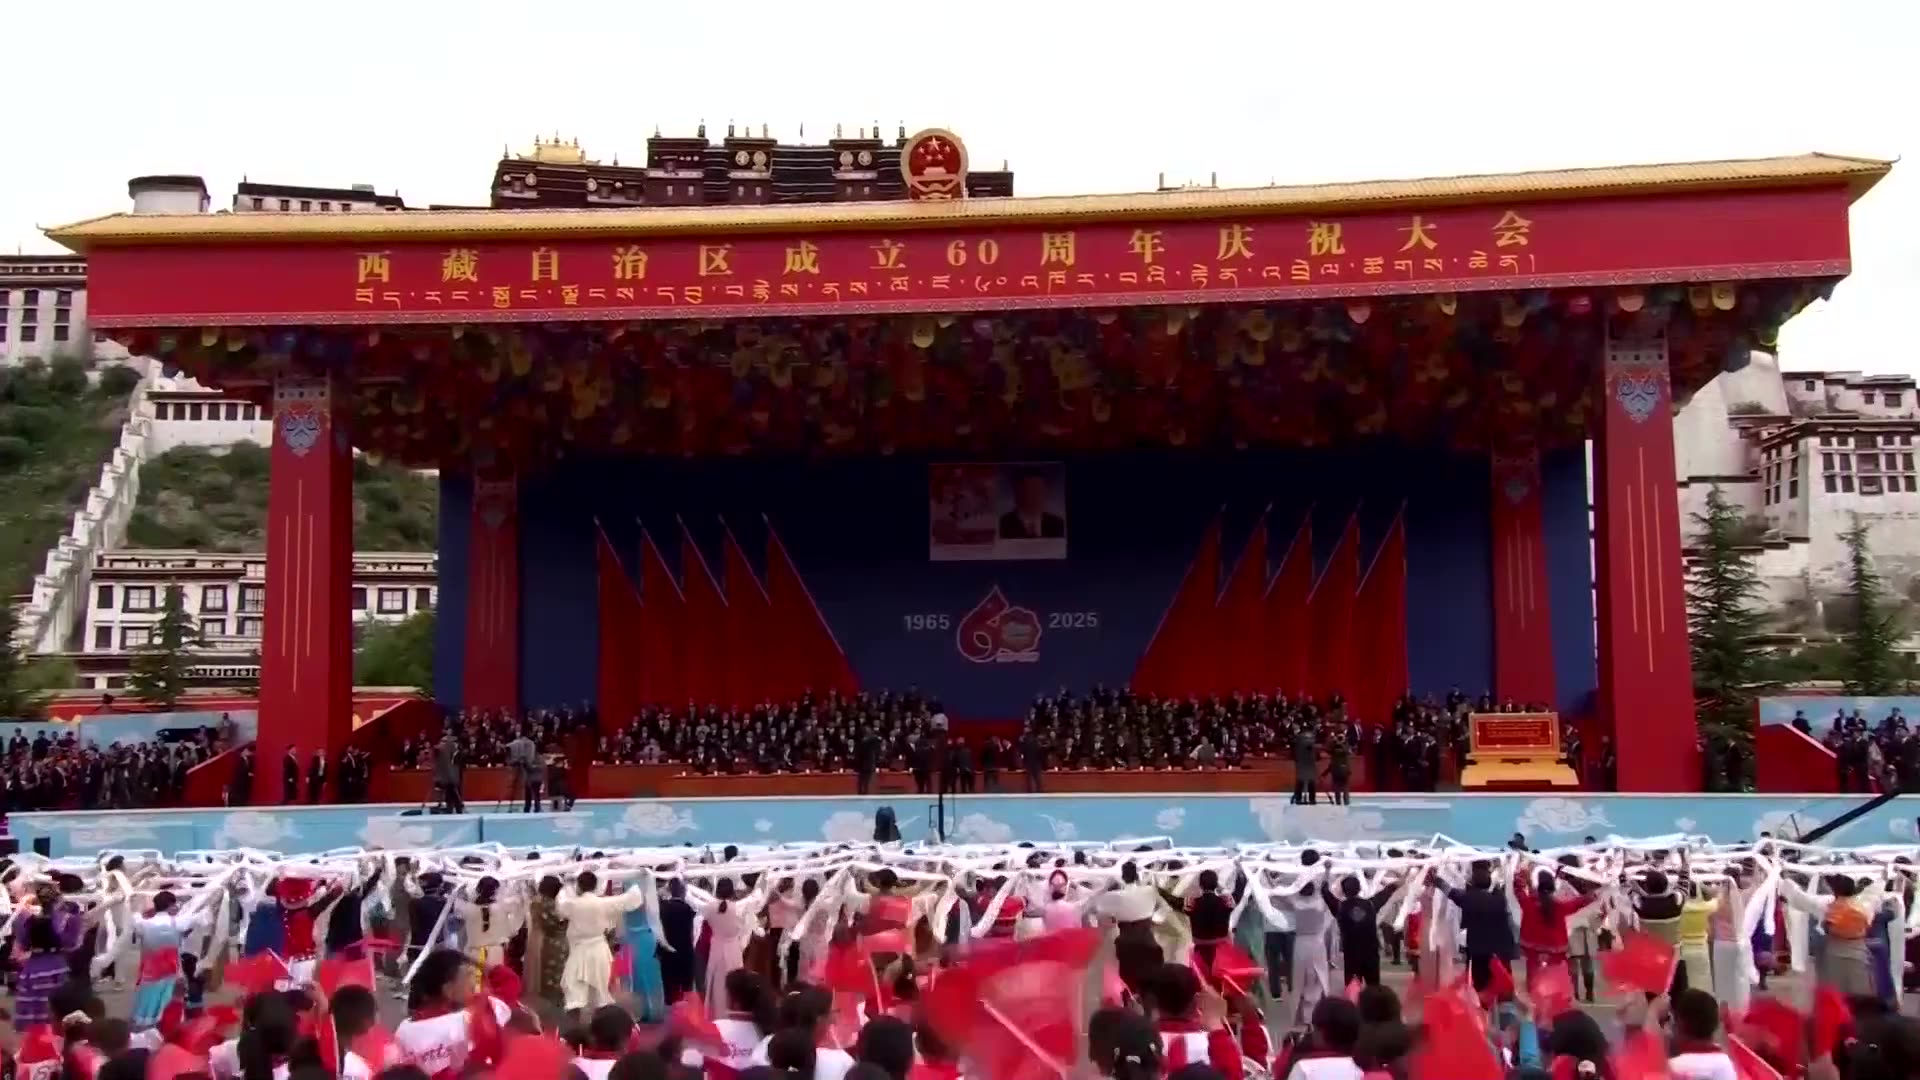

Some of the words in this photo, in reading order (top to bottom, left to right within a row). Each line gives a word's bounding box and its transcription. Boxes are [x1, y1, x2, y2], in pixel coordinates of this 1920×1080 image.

[356, 209, 1533, 284] 西藏自治区成立60周年庆祝大会
[904, 614, 949, 631] 1965
[1049, 612, 1098, 628] 2025
